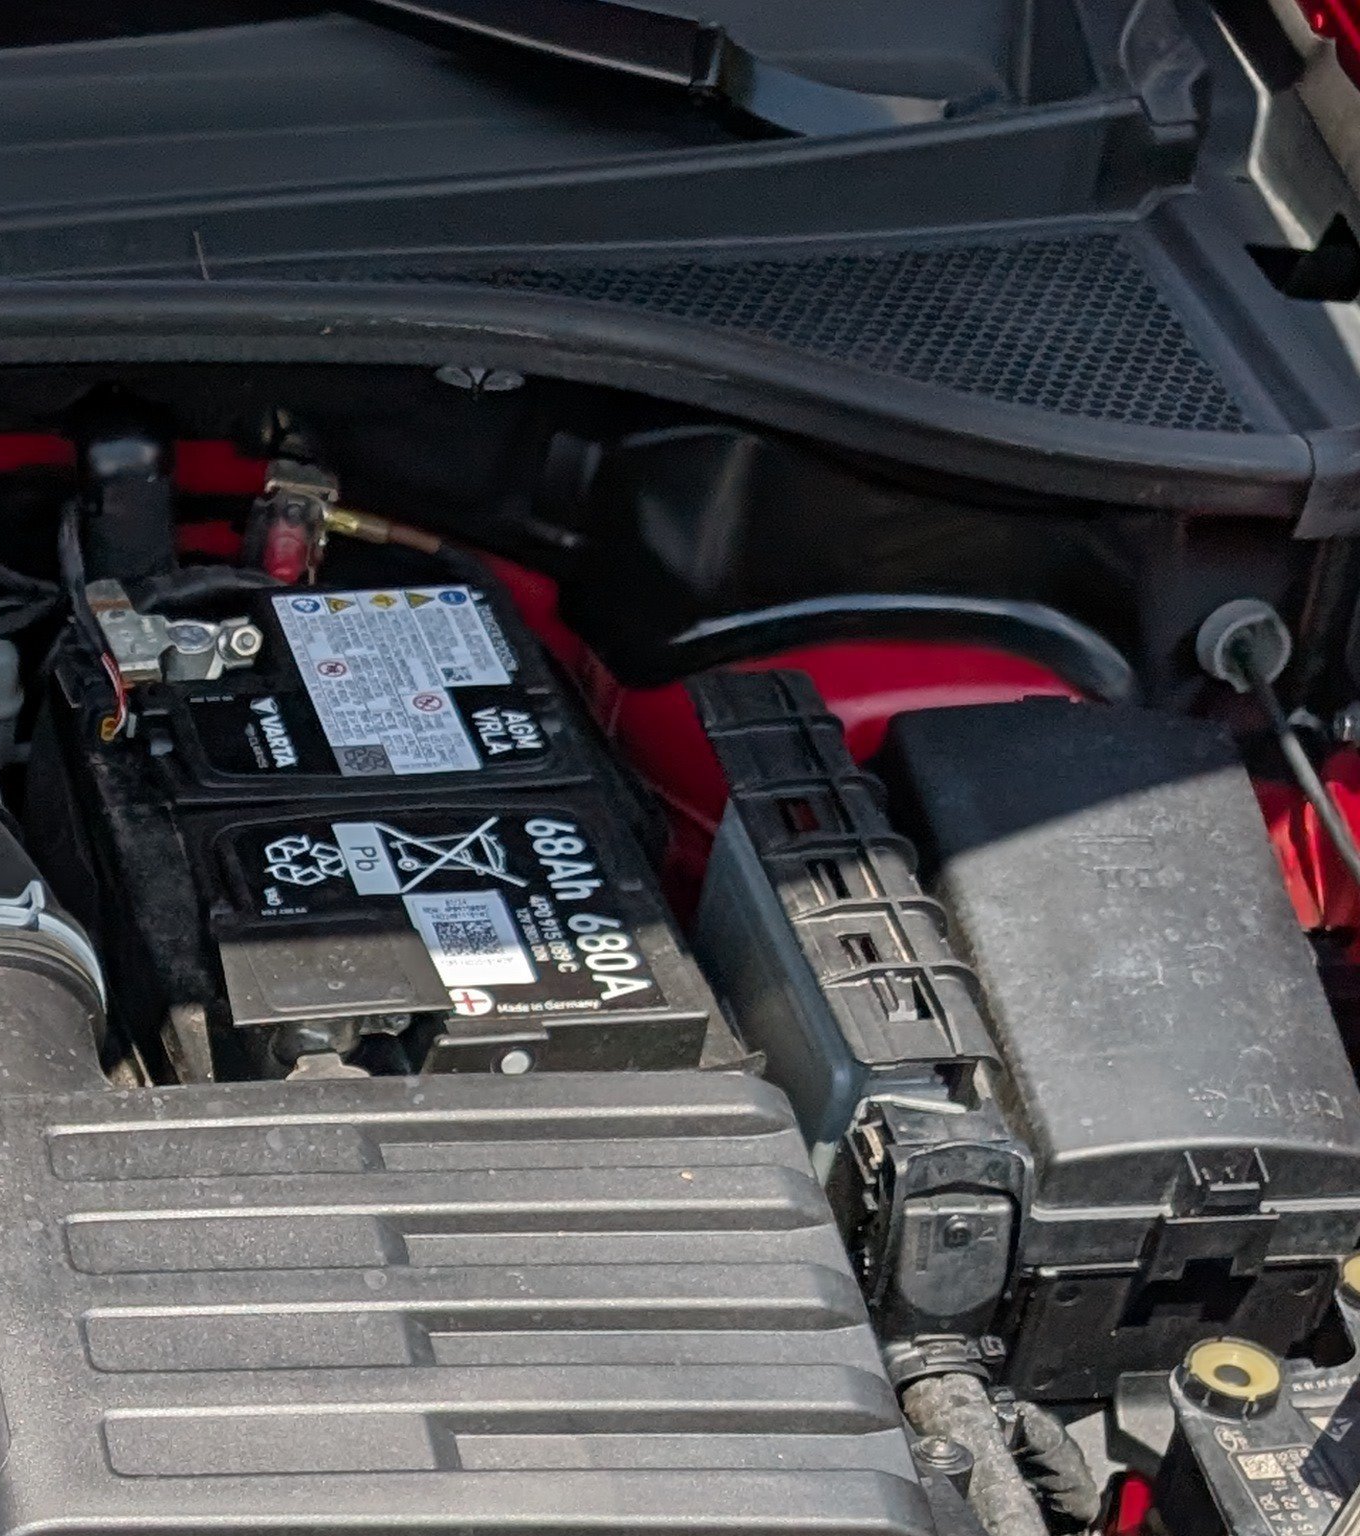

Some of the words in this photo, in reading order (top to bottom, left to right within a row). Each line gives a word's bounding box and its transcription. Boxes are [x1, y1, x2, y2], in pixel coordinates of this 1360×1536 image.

[259, 716, 298, 768] VARTA
[472, 708, 513, 754] VRLA
[502, 711, 545, 750] AGM
[348, 846, 381, 872] Pb
[524, 818, 604, 900] 68Ah
[567, 913, 652, 1000] 680A
[537, 919, 559, 940] 915
[557, 962, 580, 973] C
[497, 1000, 530, 1012] Made
[544, 998, 601, 1014] Germany
